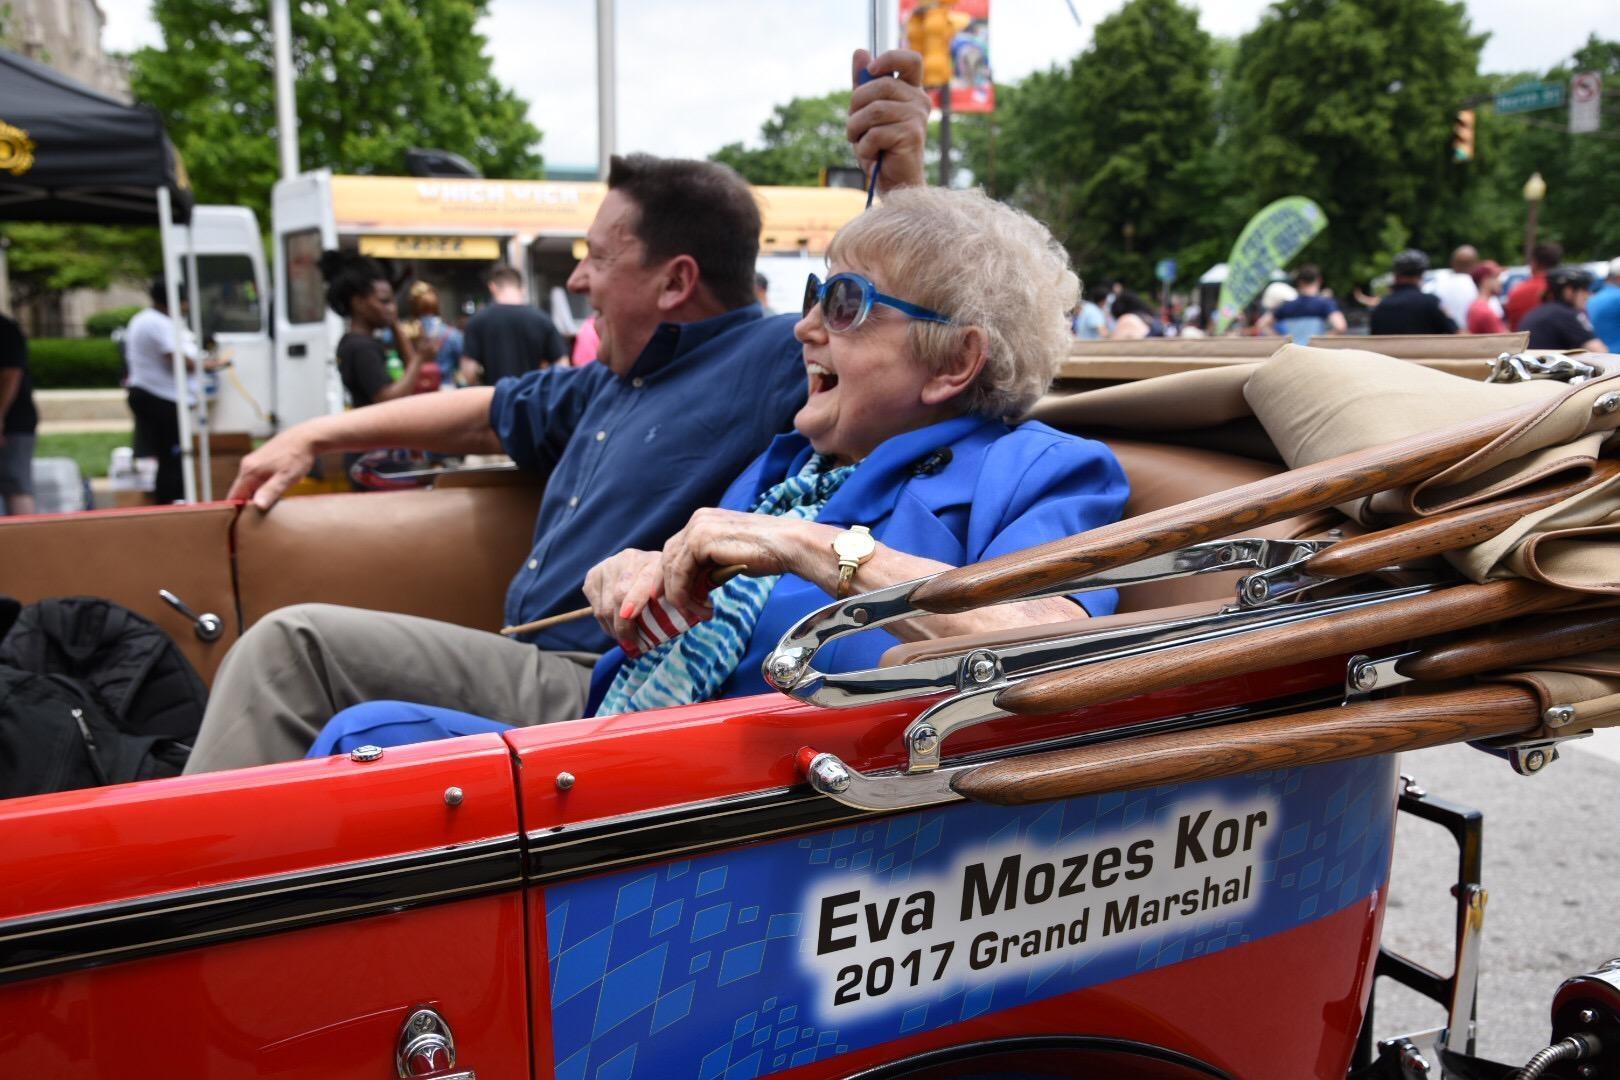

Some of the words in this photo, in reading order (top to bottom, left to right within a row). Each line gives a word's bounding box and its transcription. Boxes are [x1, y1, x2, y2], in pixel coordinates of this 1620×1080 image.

[816, 889, 936, 956] Eva
[959, 839, 1155, 922] Mozes
[1173, 809, 1268, 870] Kor
[833, 940, 955, 1007] 2017
[969, 906, 1090, 971] Grand
[1102, 865, 1252, 937] Marshal
